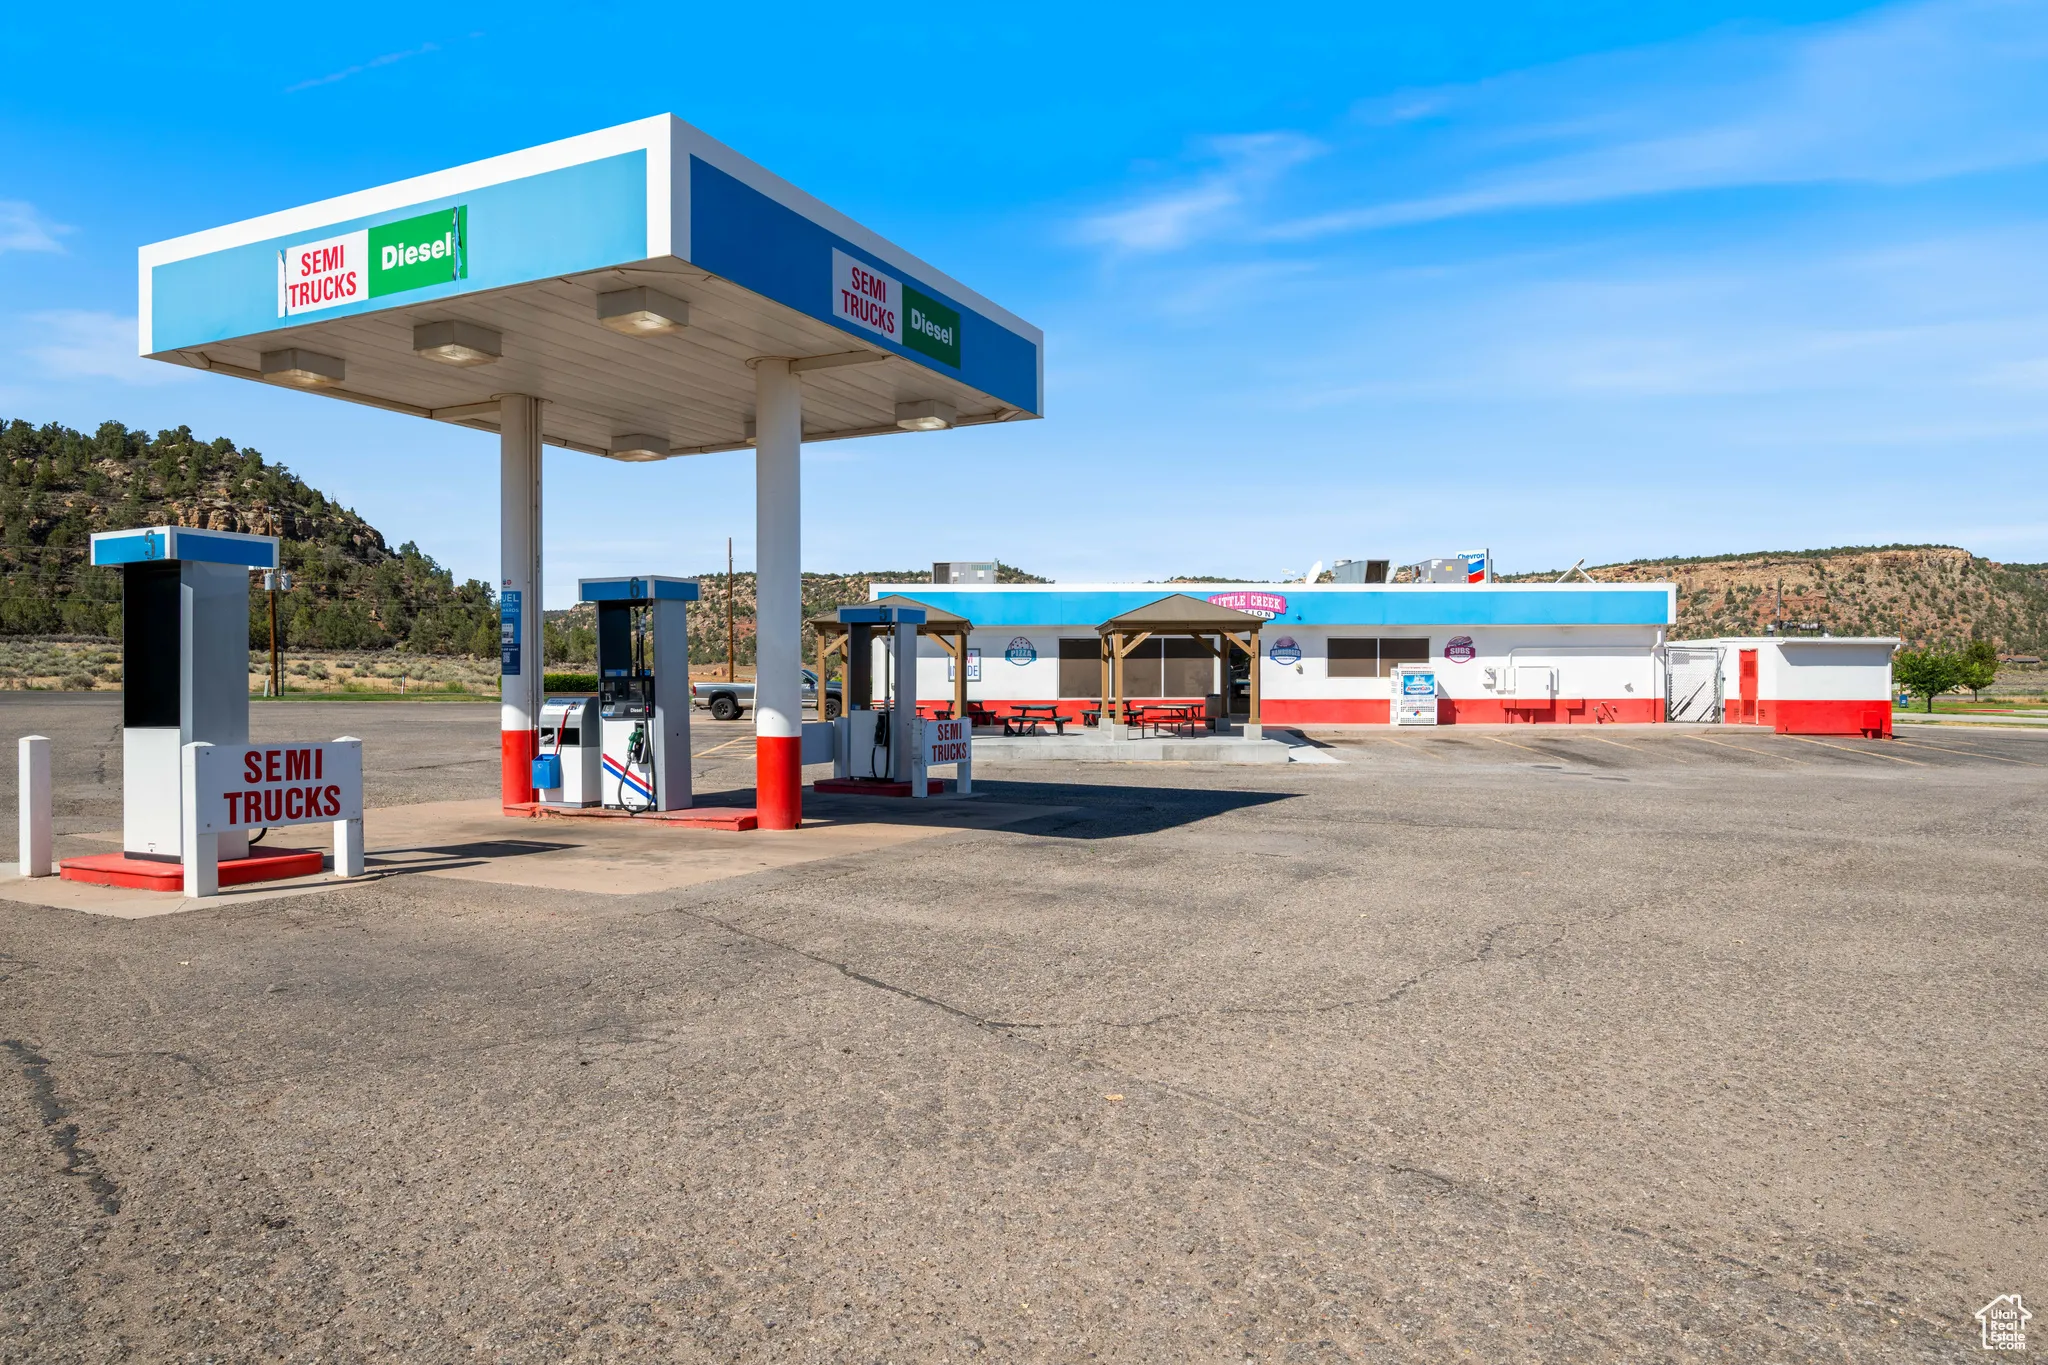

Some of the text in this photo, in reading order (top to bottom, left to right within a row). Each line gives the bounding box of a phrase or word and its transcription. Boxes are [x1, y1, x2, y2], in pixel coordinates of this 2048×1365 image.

[300, 244, 345, 277] SEMI
[381, 231, 452, 271] Diesel
[288, 271, 357, 308] TRUCKS
[851, 266, 886, 303] SEMI
[841, 288, 895, 334] TRUCKS
[911, 307, 953, 347] Diesel
[1457, 552, 1485, 560] Chevron
[630, 576, 640, 599] 6
[879, 604, 888, 622] 5
[1250, 595, 1281, 610] CREEK
[1010, 649, 1032, 658] PIZZA
[1450, 647, 1471, 655] SUBS
[937, 722, 962, 742] SEMI
[243, 748, 323, 784] SEMI
[931, 742, 967, 763] TRUCKS
[223, 784, 341, 825] TRUCKS
